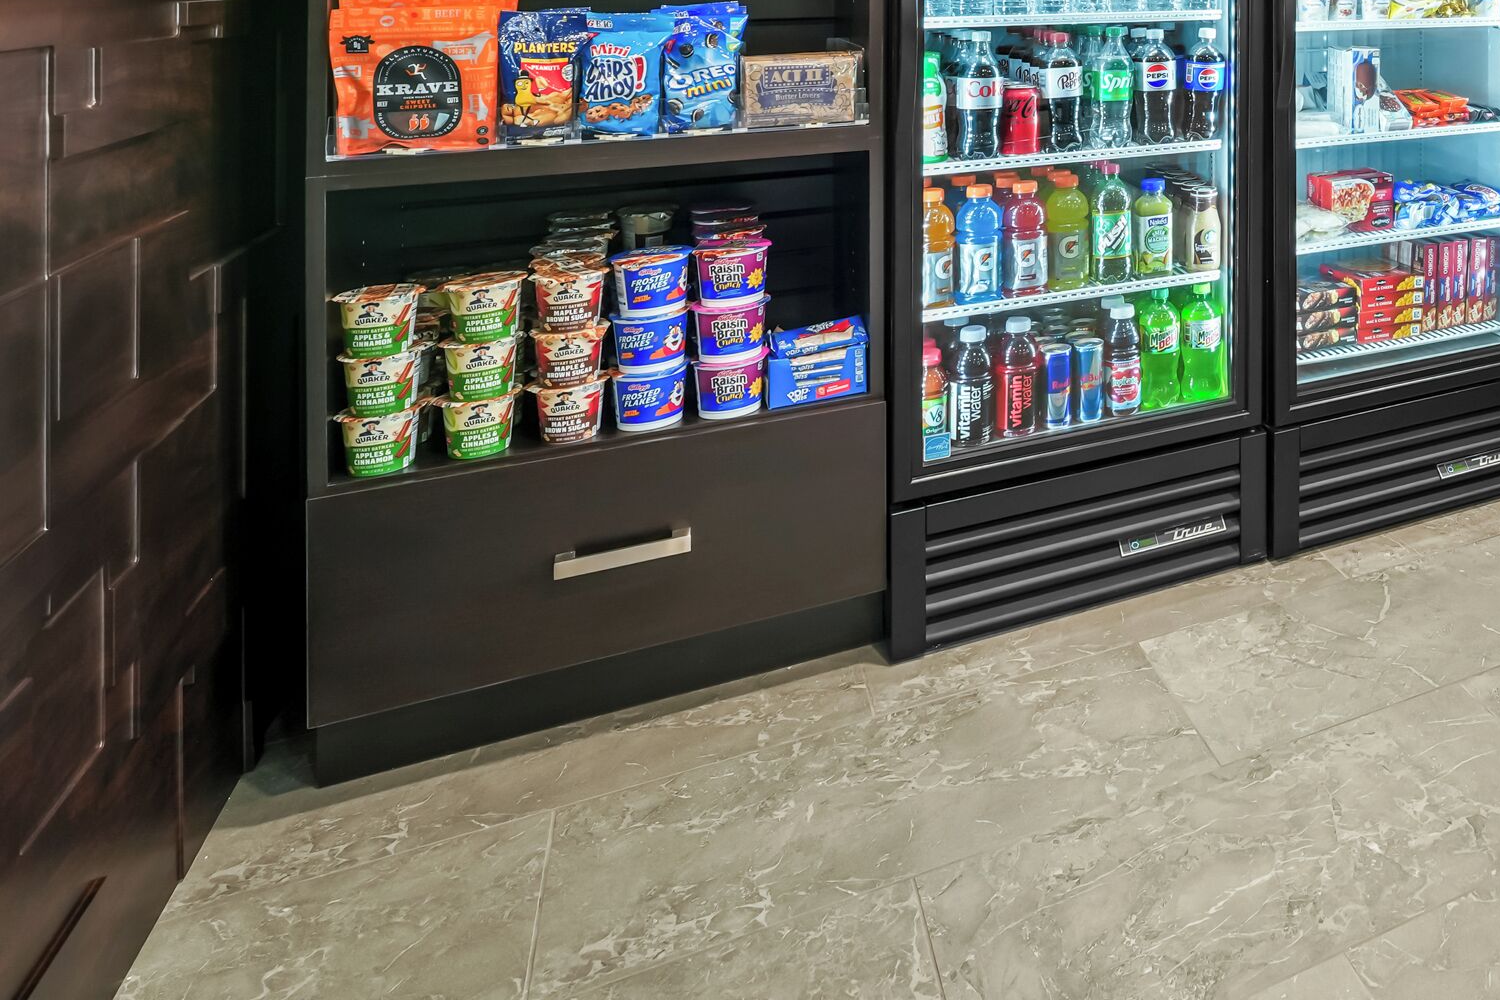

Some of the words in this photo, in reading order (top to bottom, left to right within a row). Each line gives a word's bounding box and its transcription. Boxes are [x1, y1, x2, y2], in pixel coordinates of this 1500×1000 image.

[513, 41, 577, 54] PLANTERS
[590, 44, 631, 57] Mini
[586, 56, 634, 83] Chips
[770, 69, 803, 83] ACT
[805, 68, 824, 81] II
[668, 64, 737, 89] OREO
[376, 81, 459, 96] KRAVE
[685, 77, 733, 98] mini
[775, 94, 798, 102] Butter
[798, 91, 820, 99] Lovers
[1149, 217, 1168, 226] Naked
[709, 263, 745, 276] Raisin
[631, 272, 672, 288] FROSTED
[713, 273, 742, 283] Bran
[634, 281, 668, 293] FLAKES
[713, 281, 742, 292] Crunch
[354, 316, 388, 326] QUAKER
[711, 319, 748, 332] Raisin
[353, 333, 382, 341] APPLES
[619, 331, 655, 343] FROSTED
[715, 329, 745, 341] Bran
[352, 338, 392, 347] CINNAMON
[621, 340, 651, 350] FLAKES
[716, 337, 744, 349] Crunch
[554, 364, 579, 372] MAPLE
[357, 375, 390, 384] QUAKER
[711, 374, 748, 388] Raisin
[622, 388, 661, 401] FROSTED
[715, 384, 745, 396] Bran
[1023, 375, 1032, 409] water
[356, 396, 395, 406] CINNAMON
[624, 397, 656, 408] FLAKES
[716, 393, 744, 405] Crunch
[971, 386, 981, 421] water
[1010, 375, 1023, 427] vitamin
[930, 411, 943, 422] V8
[958, 384, 971, 440] vitamin
[355, 434, 389, 444] QUAKER
[354, 455, 393, 465] CINNAMON
[355, 451, 384, 459] APPLES
